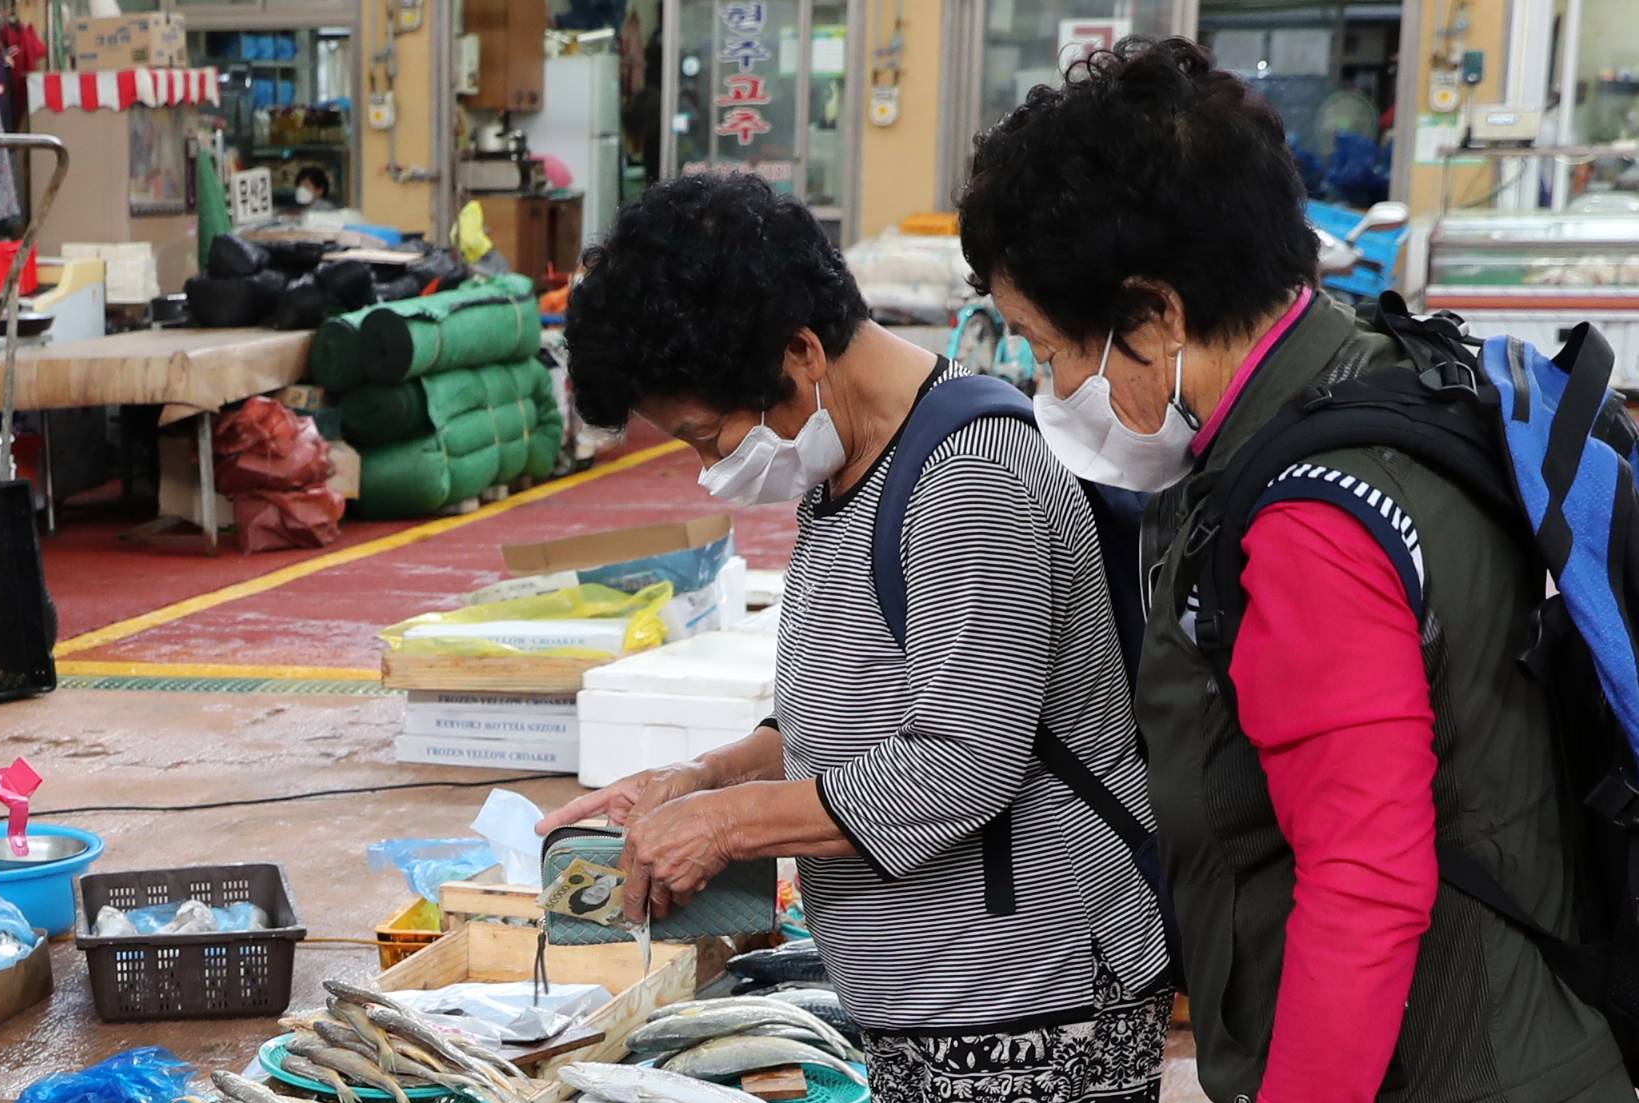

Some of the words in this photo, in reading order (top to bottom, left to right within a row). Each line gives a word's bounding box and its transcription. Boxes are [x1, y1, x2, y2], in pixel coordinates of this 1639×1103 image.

[438, 693, 478, 703] FROZEN
[480, 694, 521, 705] YELLOW
[525, 696, 576, 706] CROAKER
[435, 718, 481, 730] CROAKER
[484, 721, 525, 732] YELLOW
[527, 723, 567, 733] FROZEN
[426, 746, 466, 757] FROZEN
[467, 748, 506, 760] YELLOW
[509, 750, 556, 762] CROAKER
